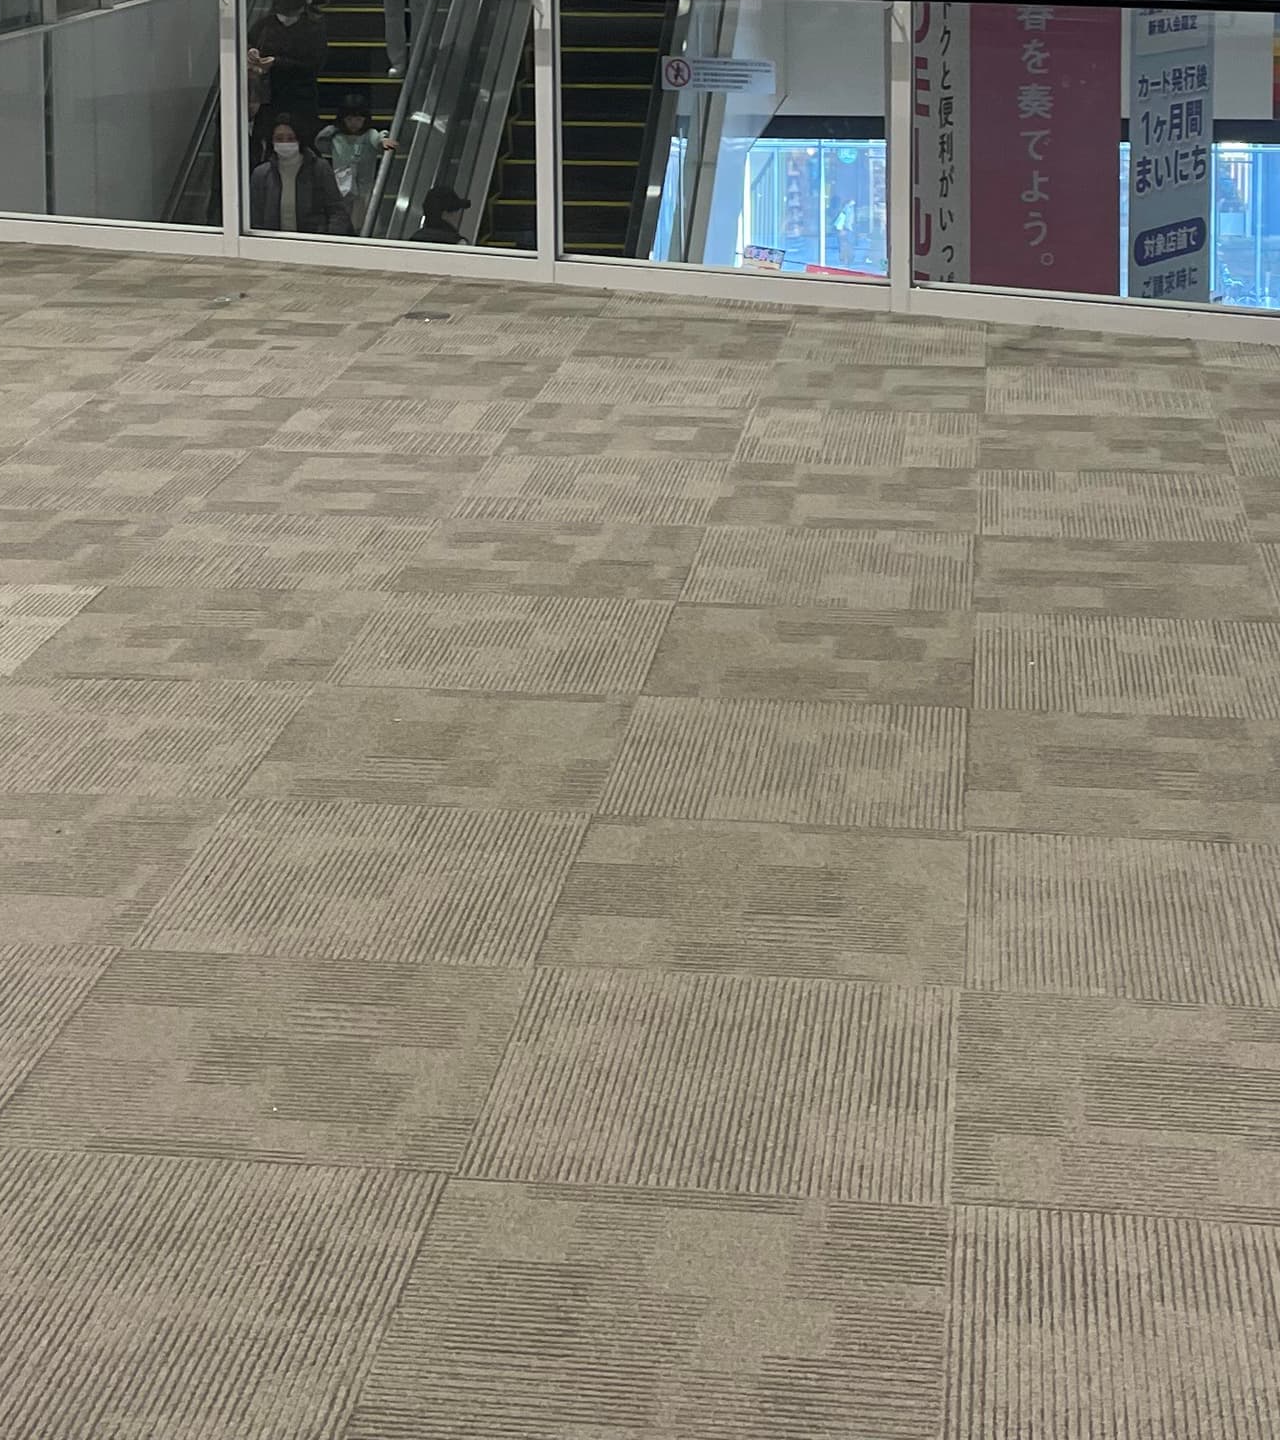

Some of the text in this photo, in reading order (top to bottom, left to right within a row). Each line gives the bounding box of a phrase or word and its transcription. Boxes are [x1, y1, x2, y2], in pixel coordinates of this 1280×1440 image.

[1138, 64, 1208, 98] カード発行後
[1136, 144, 1207, 194] まいにち
[1143, 226, 1198, 259] 対象店舗で
